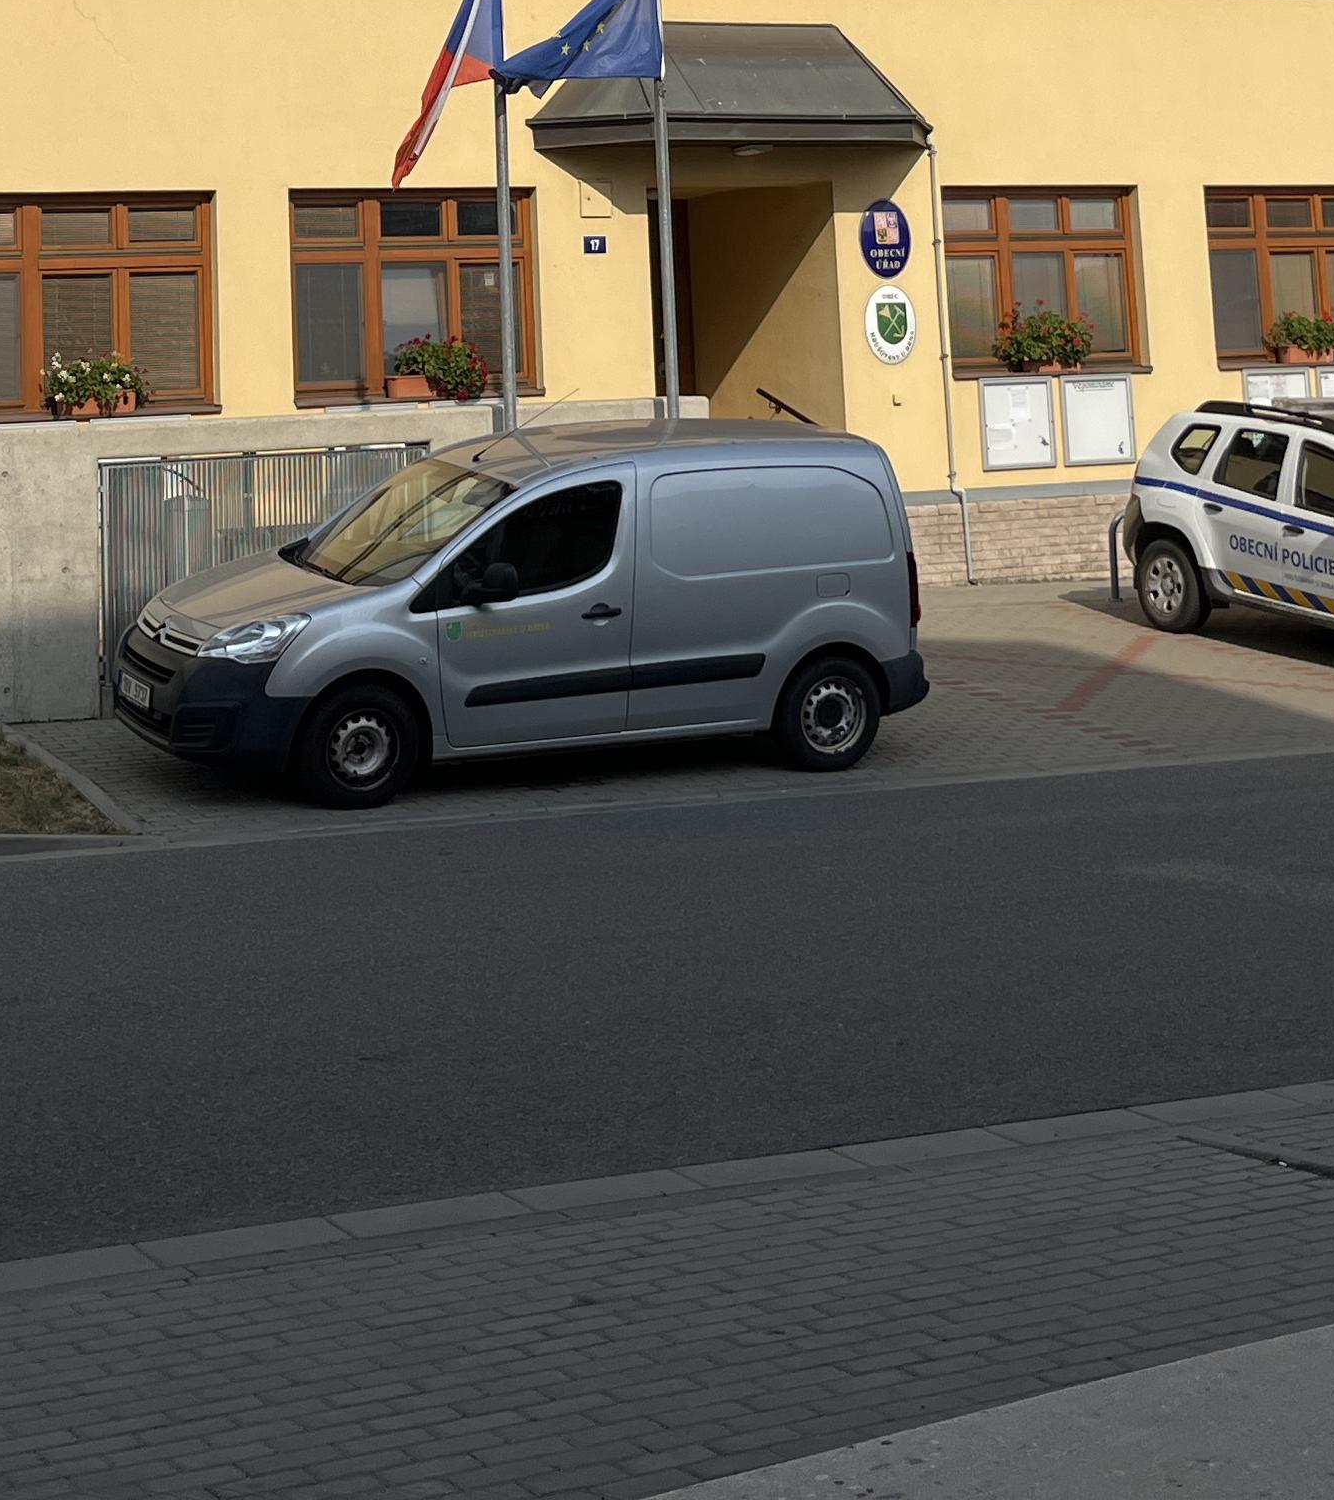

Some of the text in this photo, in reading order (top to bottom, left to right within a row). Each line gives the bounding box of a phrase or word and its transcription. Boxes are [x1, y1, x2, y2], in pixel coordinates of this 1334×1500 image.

[589, 239, 600, 251] 17
[870, 247, 905, 257] OBECNÍ
[876, 259, 900, 270] ÚŘAD
[1229, 534, 1279, 562] OBECNÍ
